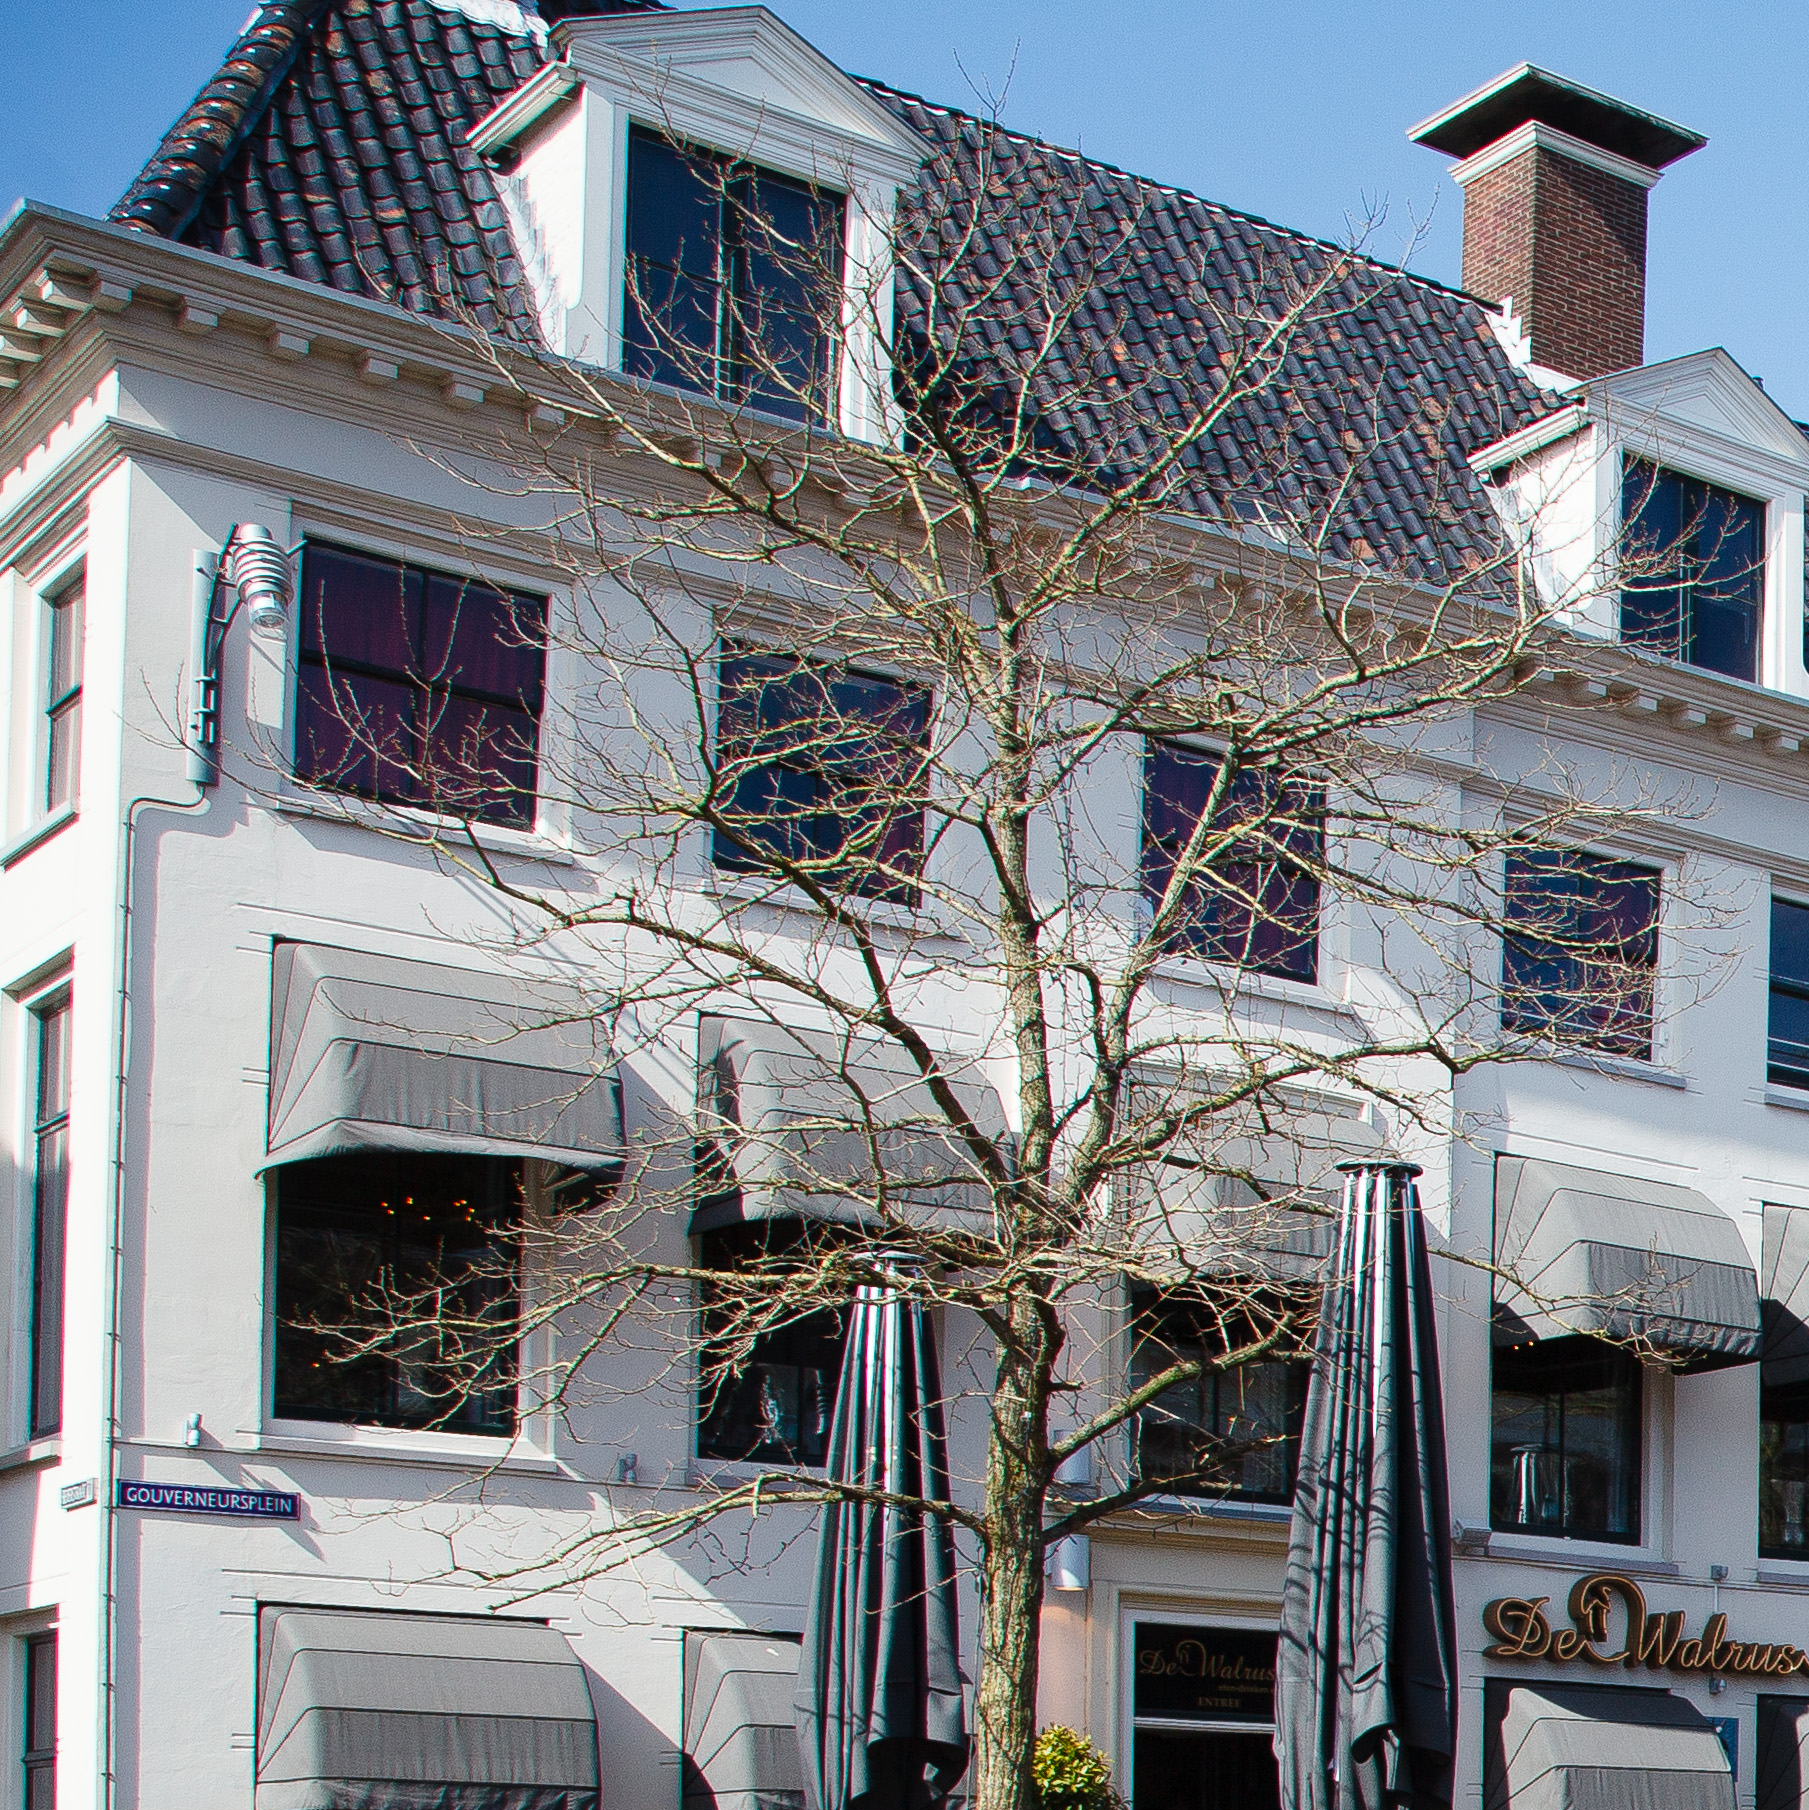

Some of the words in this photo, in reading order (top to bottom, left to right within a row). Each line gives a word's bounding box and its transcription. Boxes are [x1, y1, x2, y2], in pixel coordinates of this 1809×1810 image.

[126, 1487, 292, 1514] GOUVERNEURSPLEIN
[1482, 1596, 1592, 1660] De
[1140, 1649, 1178, 1676] De
[1199, 1697, 1241, 1708] ENTREE
